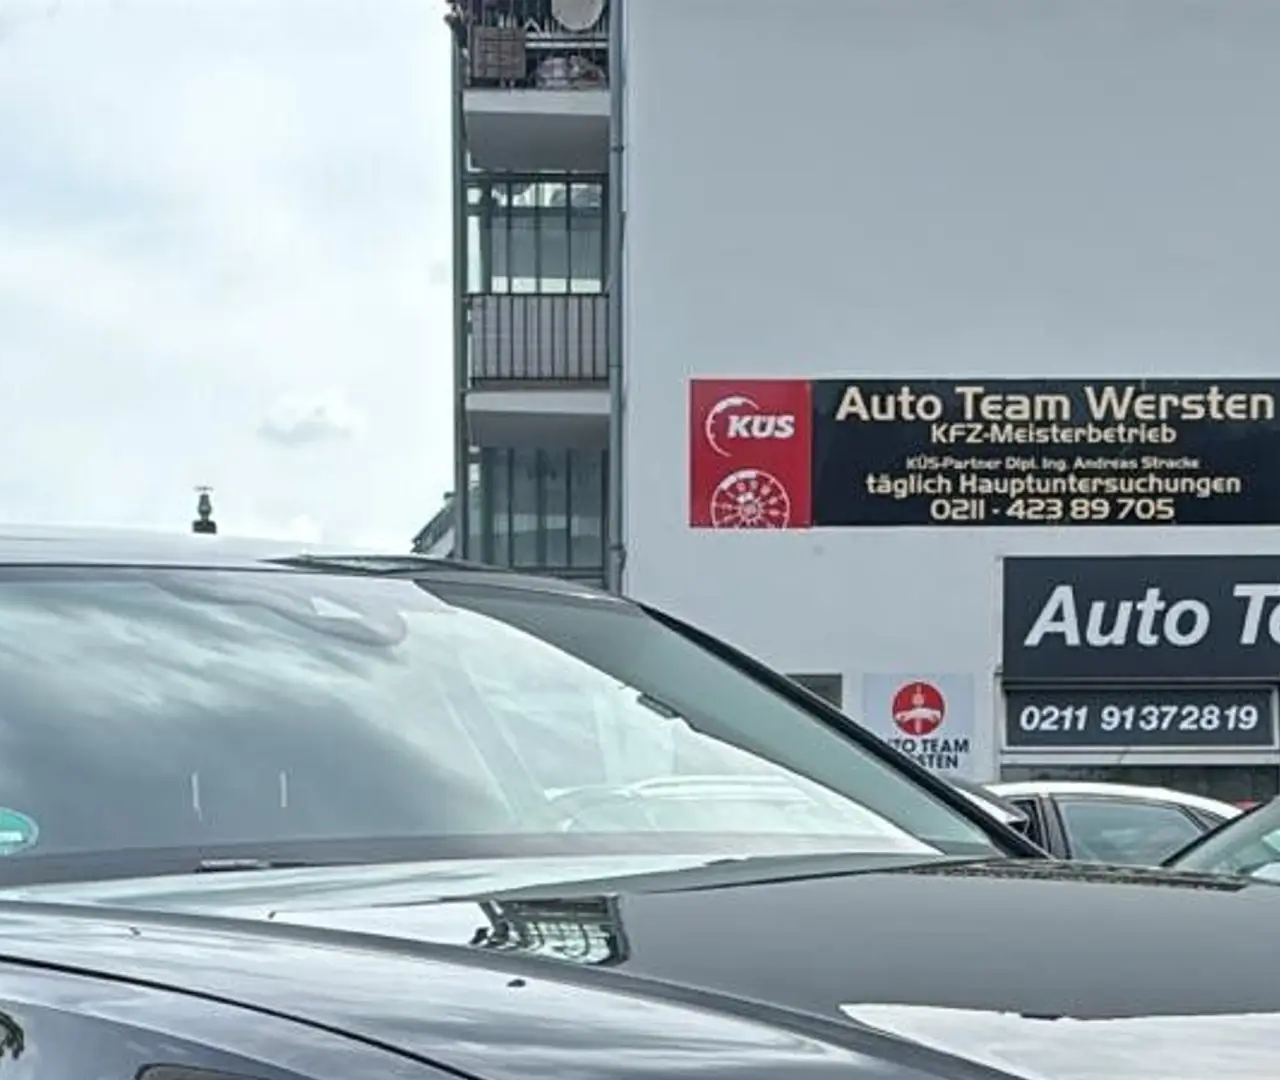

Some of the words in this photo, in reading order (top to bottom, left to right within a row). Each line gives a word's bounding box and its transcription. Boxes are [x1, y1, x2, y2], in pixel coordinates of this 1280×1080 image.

[835, 386, 942, 421] Auto
[955, 386, 1070, 421] Team
[1085, 386, 1274, 421] Wersten
[931, 423, 1176, 443] KFZ-Meisterbetrieb
[1074, 456, 1138, 469] Andreas
[866, 474, 952, 497] täglich
[959, 474, 1241, 497] Hauptuntersuchungen
[930, 499, 985, 519] 0211
[1005, 499, 1062, 519] 423
[1070, 499, 1110, 519] 89
[1117, 499, 1174, 519] 705
[1023, 584, 1211, 648] Auto
[1019, 705, 1088, 731] 0211
[1100, 705, 1259, 731] 91372819
[921, 738, 970, 753] TEAM
